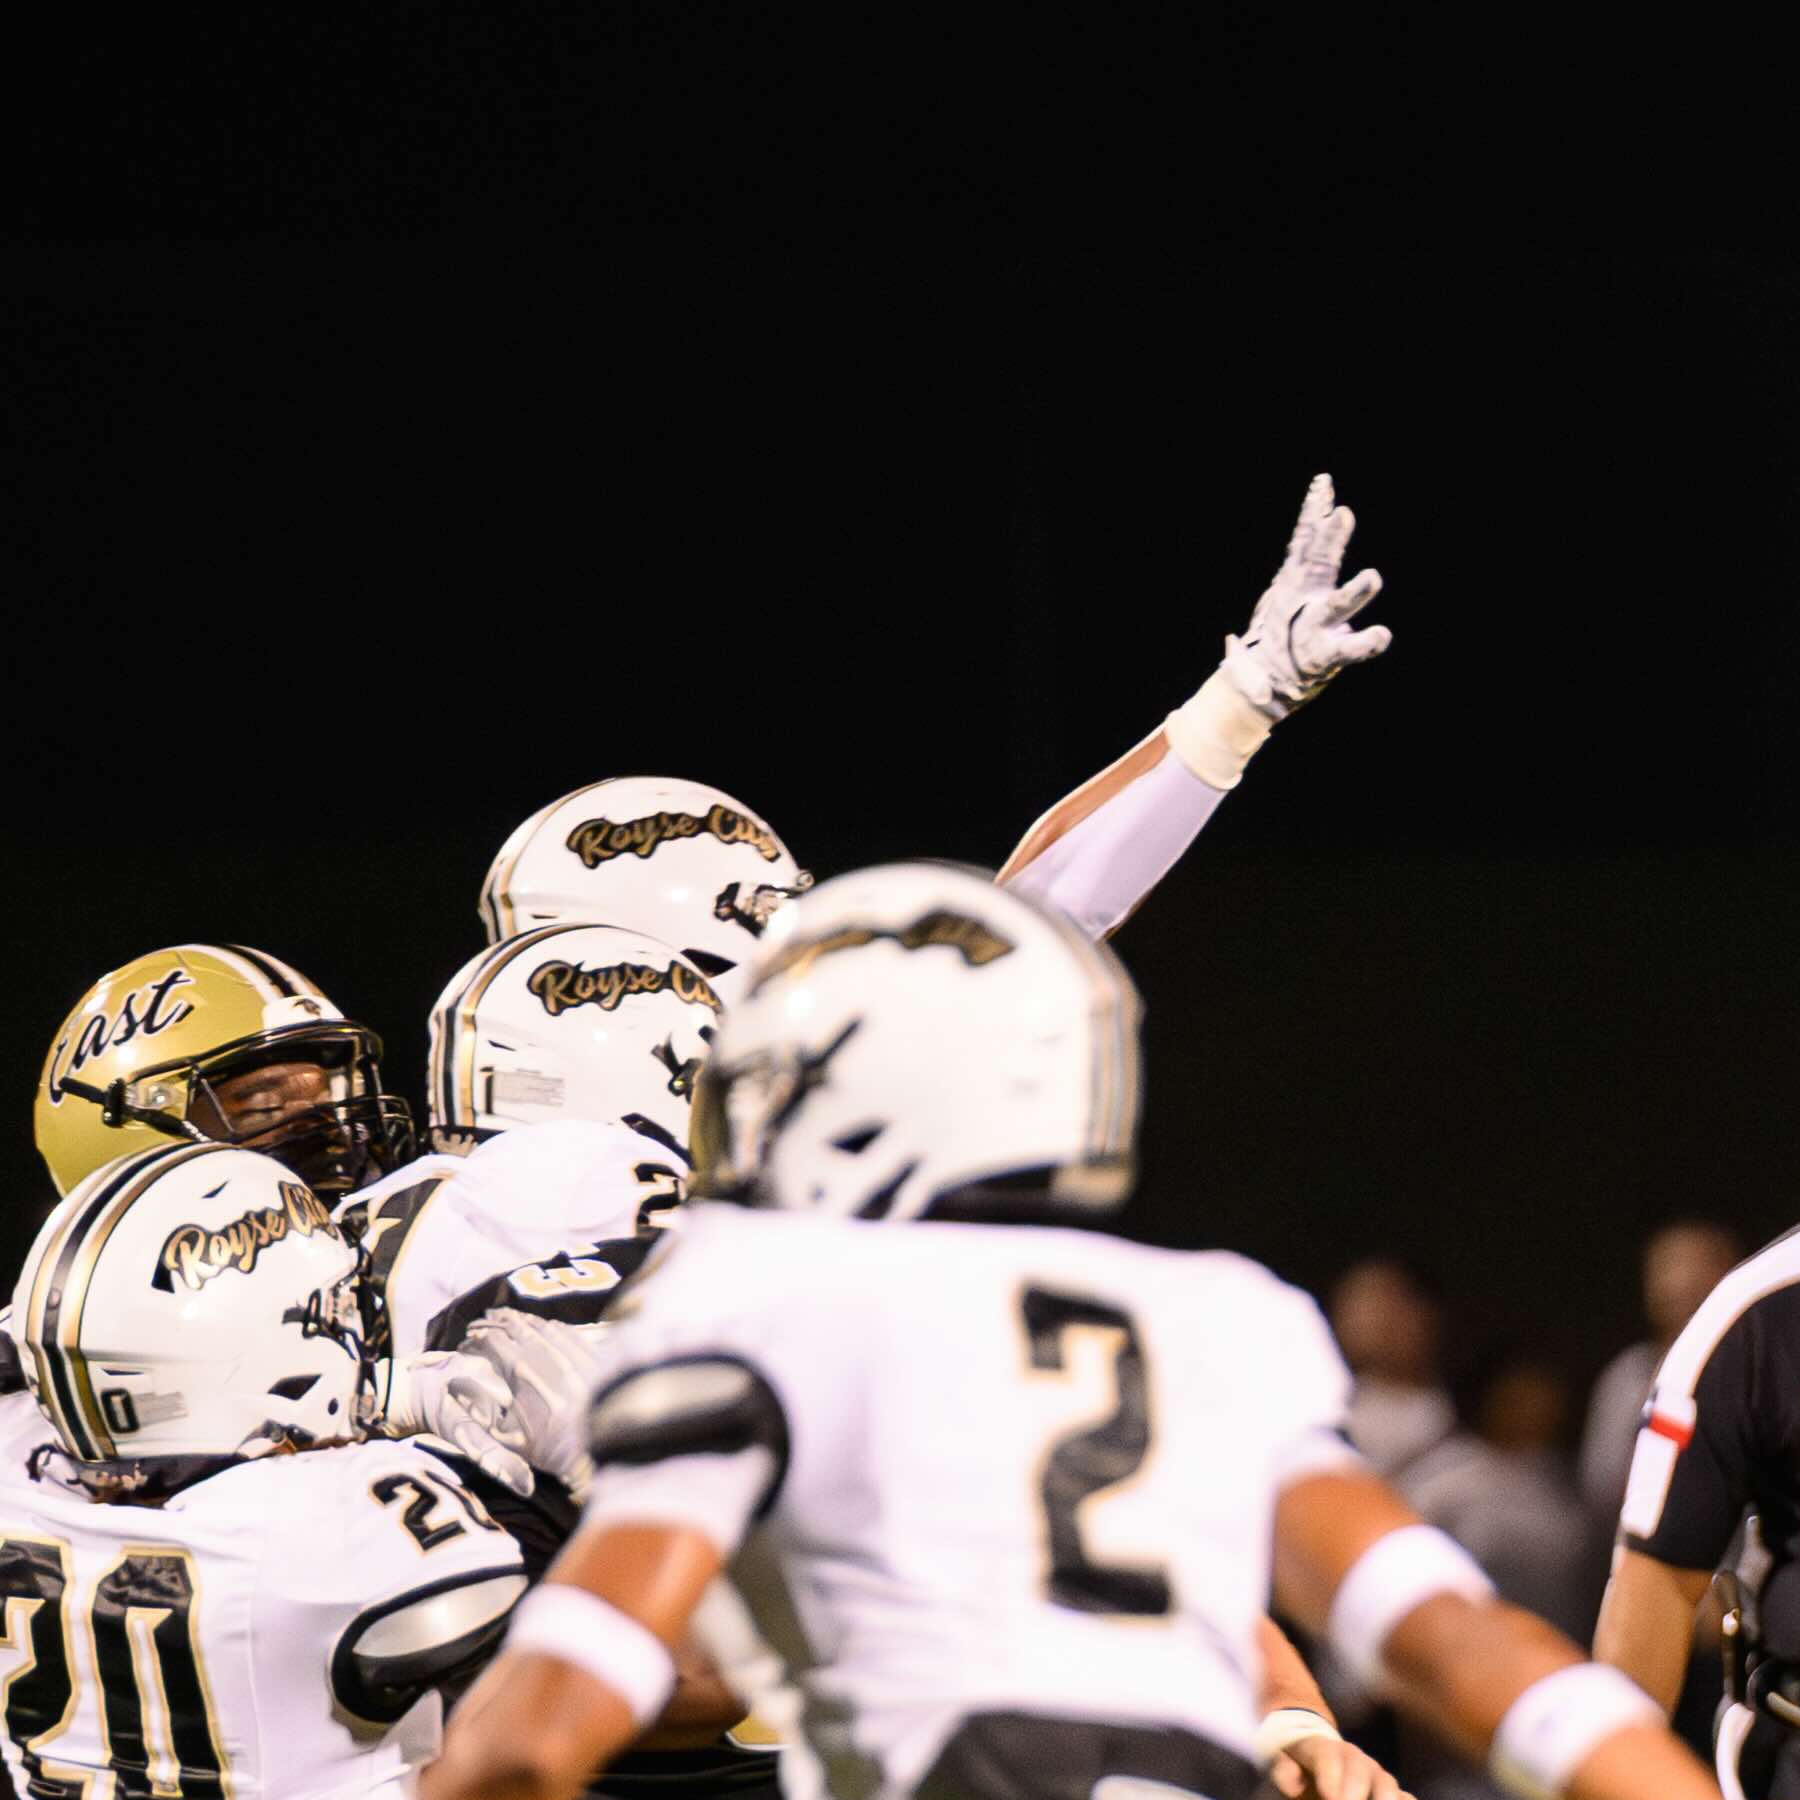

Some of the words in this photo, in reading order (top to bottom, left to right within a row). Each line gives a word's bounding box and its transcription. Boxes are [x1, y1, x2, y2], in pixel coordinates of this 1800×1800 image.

[526, 960, 664, 1016] Royse
[163, 1223, 288, 1291] Royse
[101, 1388, 140, 1433] 0
[1015, 1278, 1174, 1617] 2
